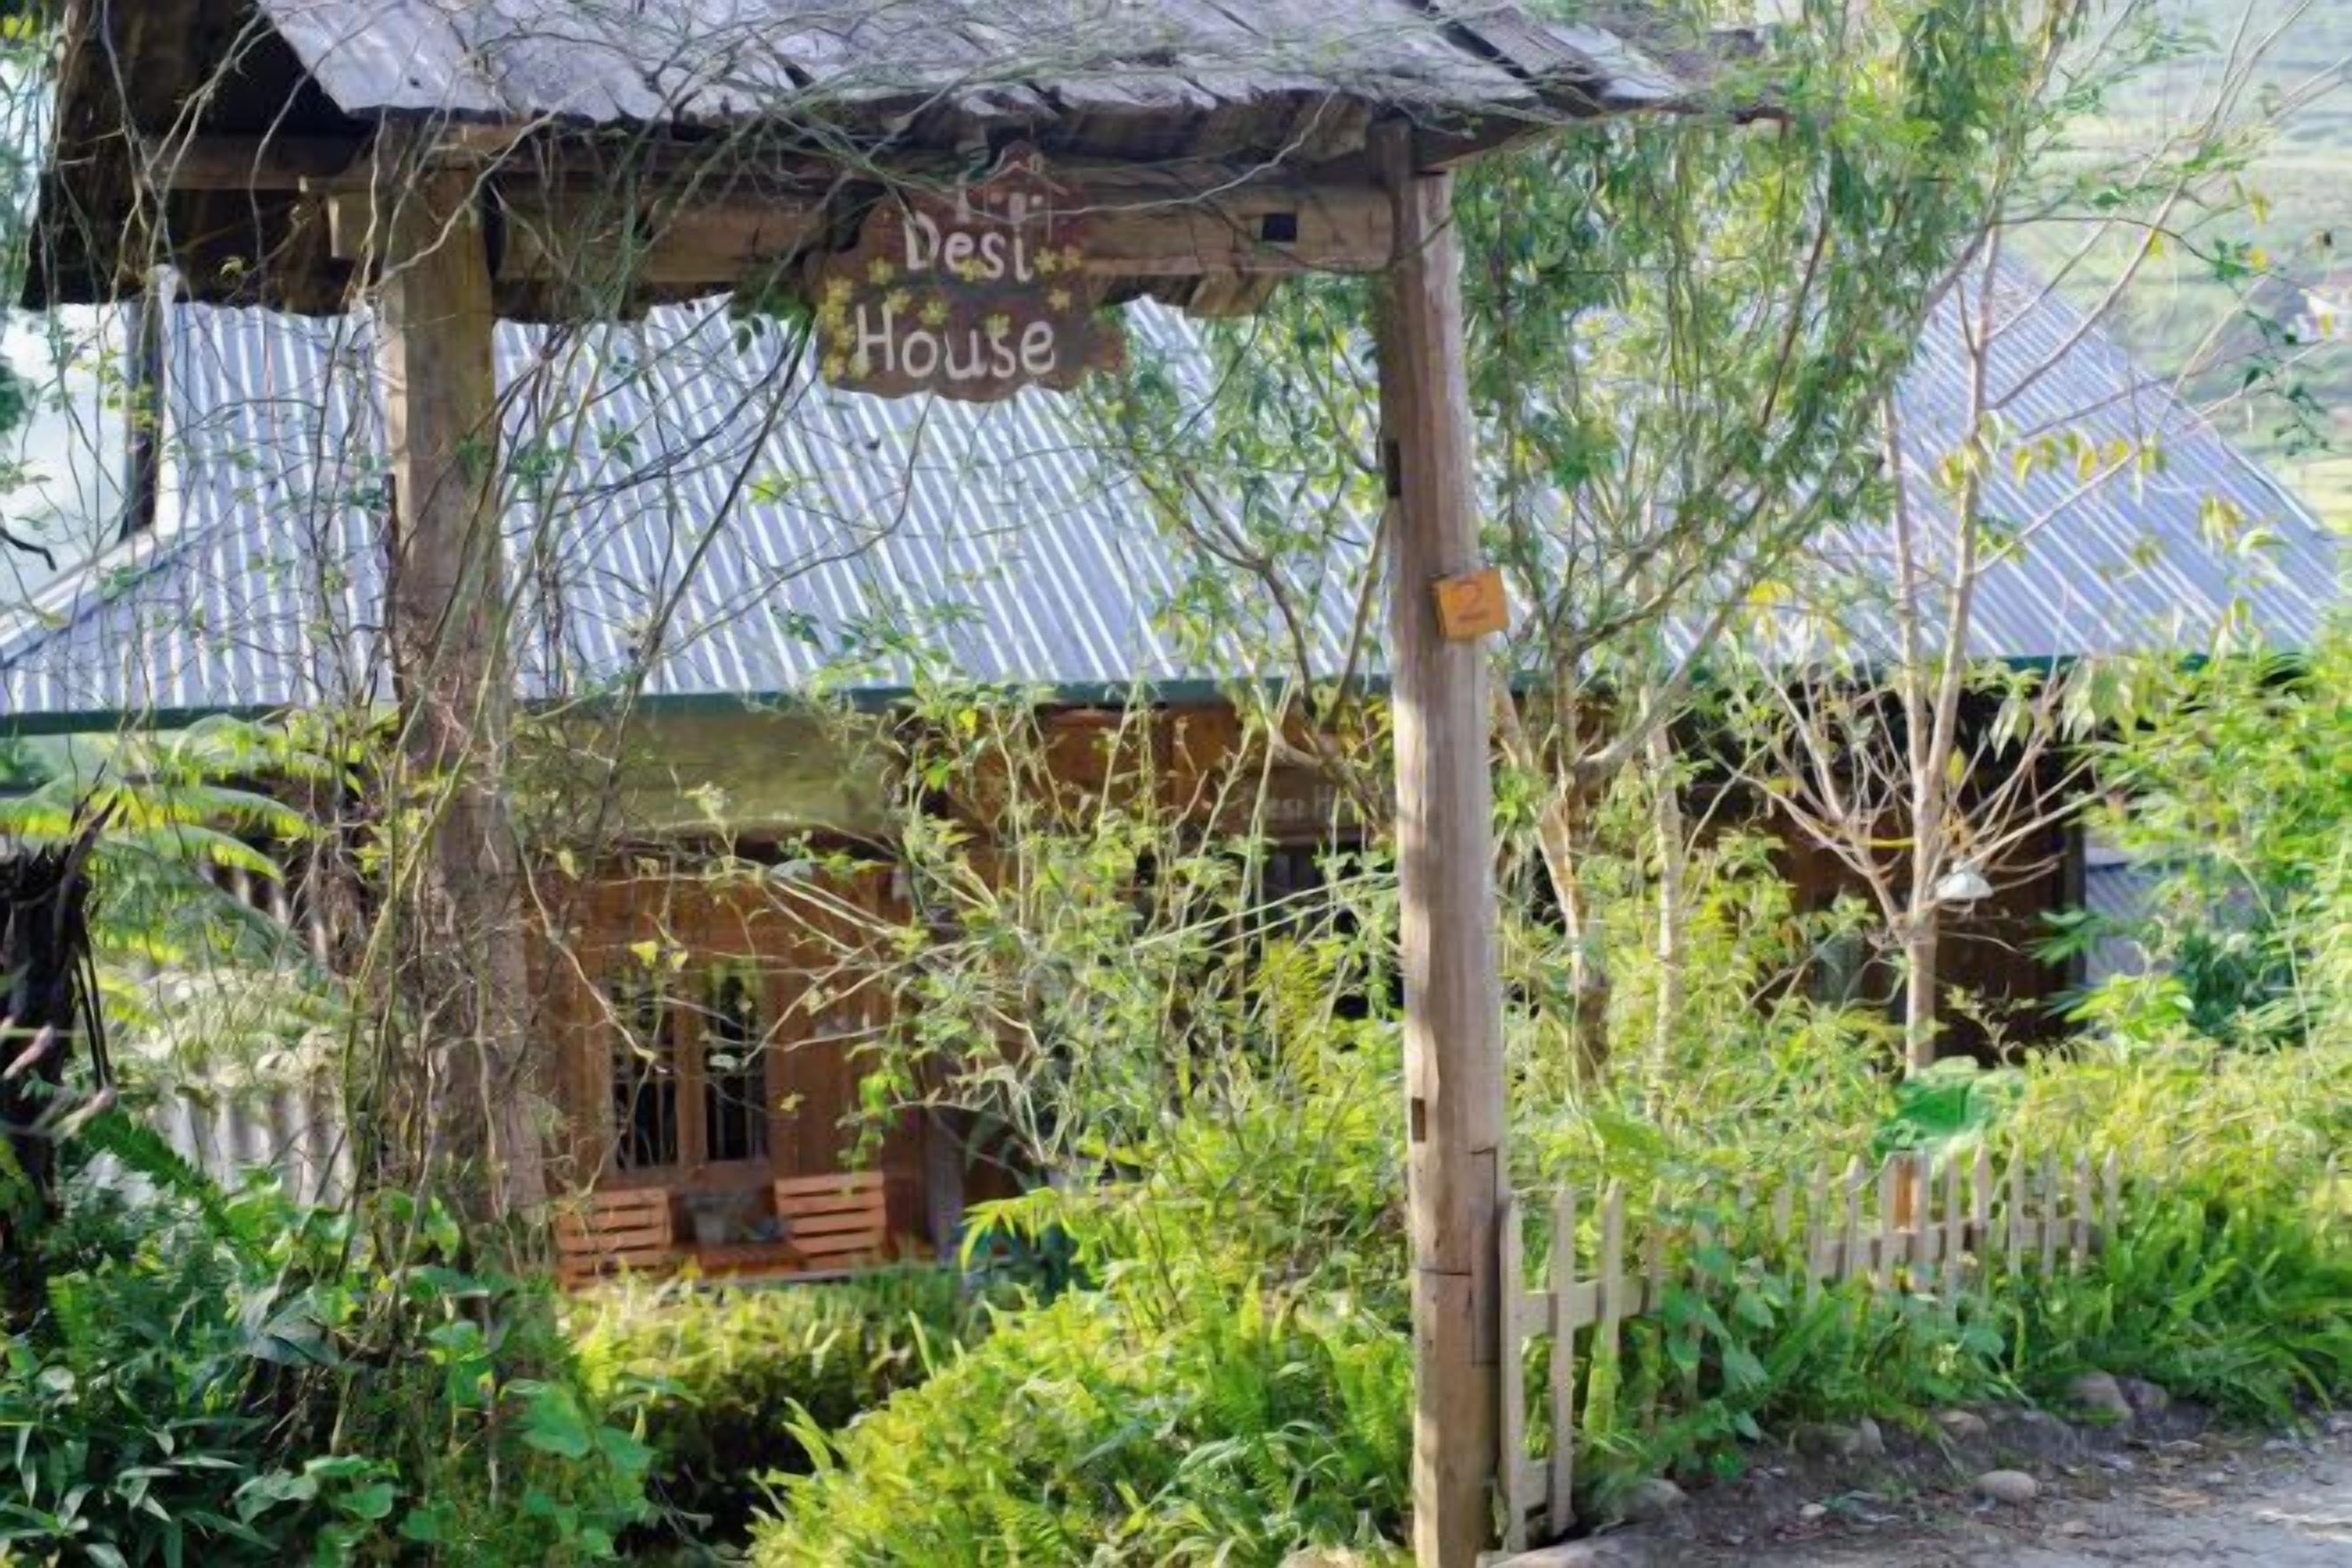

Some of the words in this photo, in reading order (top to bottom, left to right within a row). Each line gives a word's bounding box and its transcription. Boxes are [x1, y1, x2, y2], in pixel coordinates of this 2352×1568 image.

[903, 211, 1033, 283] Desi
[856, 304, 1057, 380] House
[1456, 580, 1490, 623] 2
